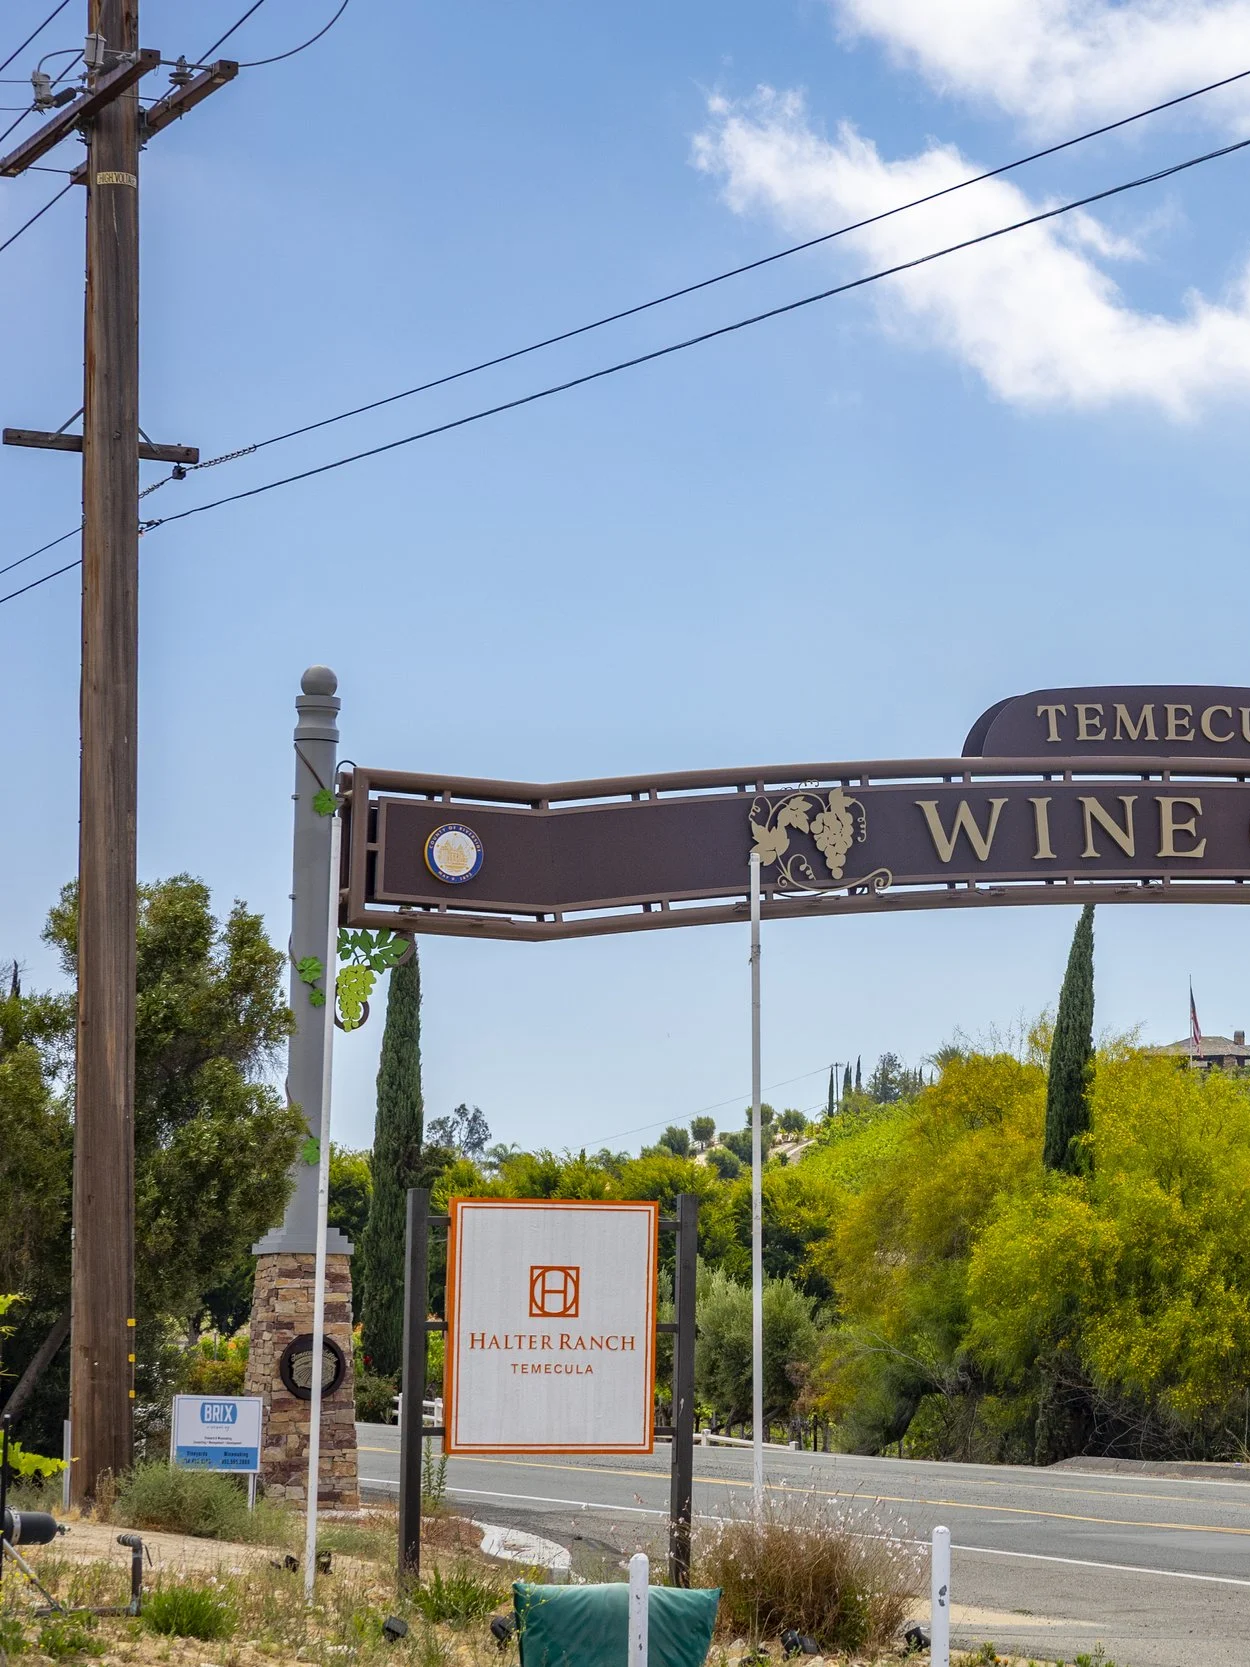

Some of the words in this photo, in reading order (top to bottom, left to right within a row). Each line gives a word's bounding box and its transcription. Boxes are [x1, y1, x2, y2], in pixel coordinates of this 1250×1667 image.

[914, 796, 1207, 863] WINE
[429, 828, 445, 848] COUNTY
[459, 827, 481, 852] RIVERSIDE
[469, 1332, 554, 1350] HALTER
[558, 1333, 636, 1351] RANCH
[511, 1363, 594, 1375] TEMECULA
[204, 1404, 234, 1423] BRIX
